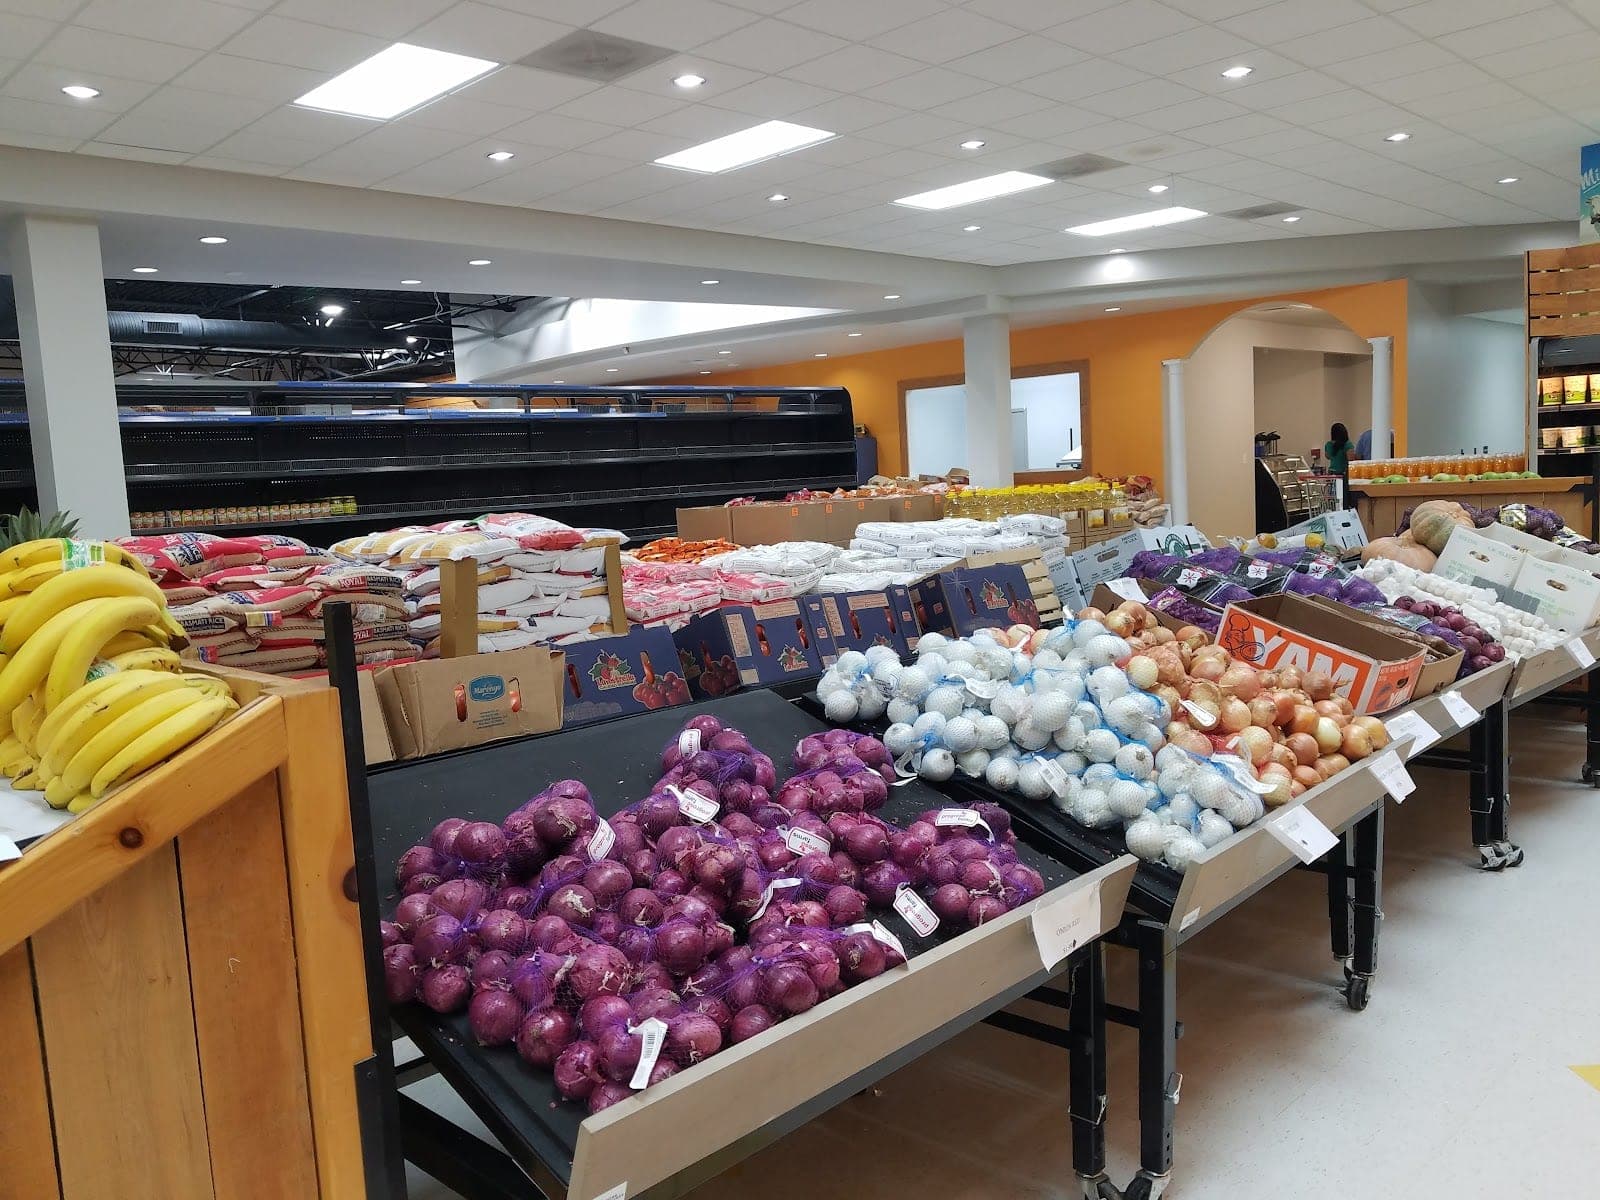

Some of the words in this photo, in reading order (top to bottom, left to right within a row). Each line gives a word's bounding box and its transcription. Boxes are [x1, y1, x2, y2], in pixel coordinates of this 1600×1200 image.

[341, 576, 365, 588] ROYAL
[210, 616, 225, 625] RICE
[353, 630, 370, 641] OYAL
[1253, 627, 1358, 699] YAM
[791, 832, 810, 843] farms
[903, 892, 917, 908] farms
